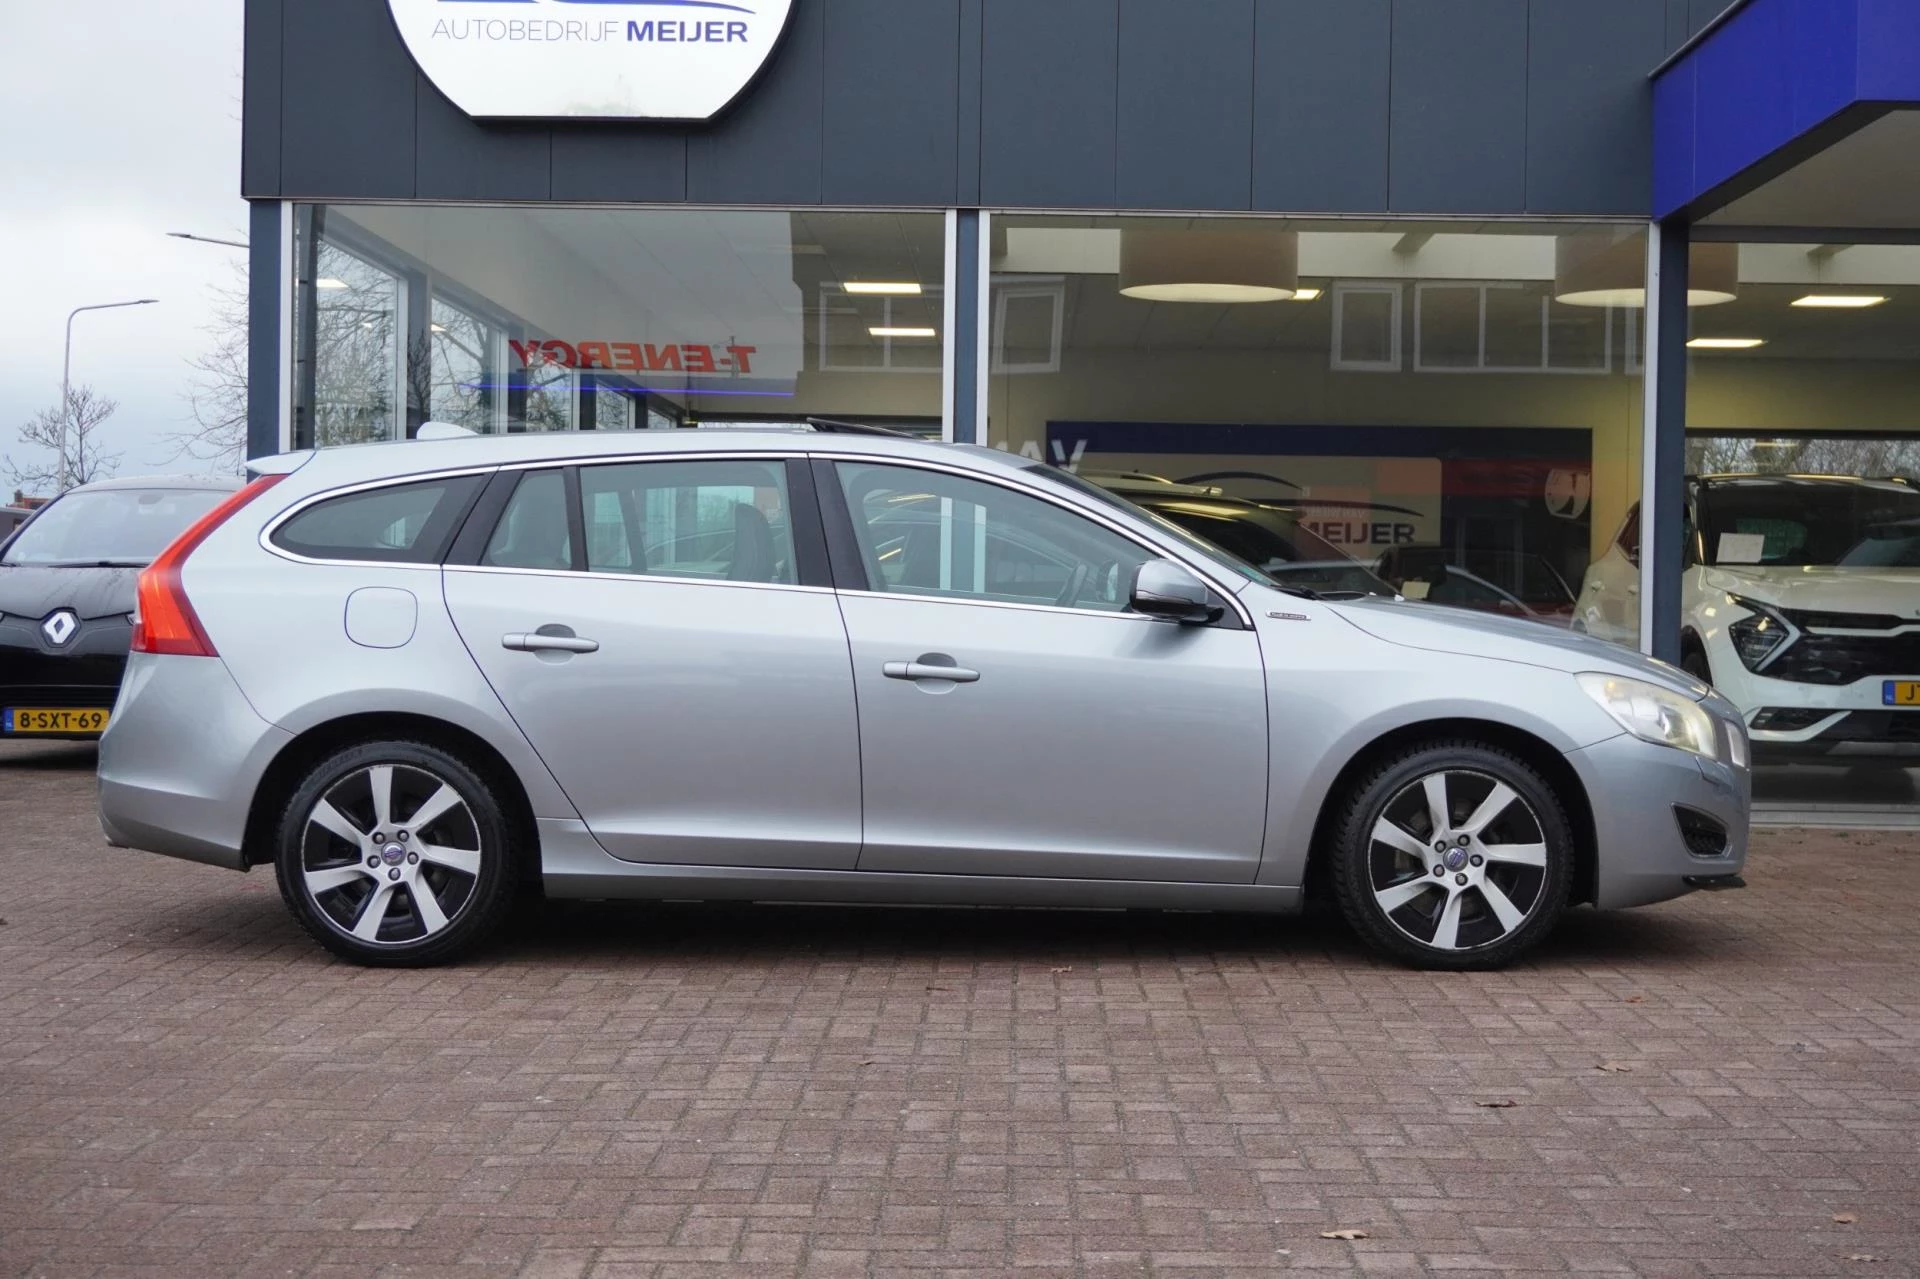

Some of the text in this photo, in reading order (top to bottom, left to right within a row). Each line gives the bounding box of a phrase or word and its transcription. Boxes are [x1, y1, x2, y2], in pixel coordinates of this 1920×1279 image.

[431, 18, 748, 43] AUTOBEDRIJF MEIJER
[1905, 683, 1920, 701] J
[20, 712, 102, 729] 8-SXT-69
